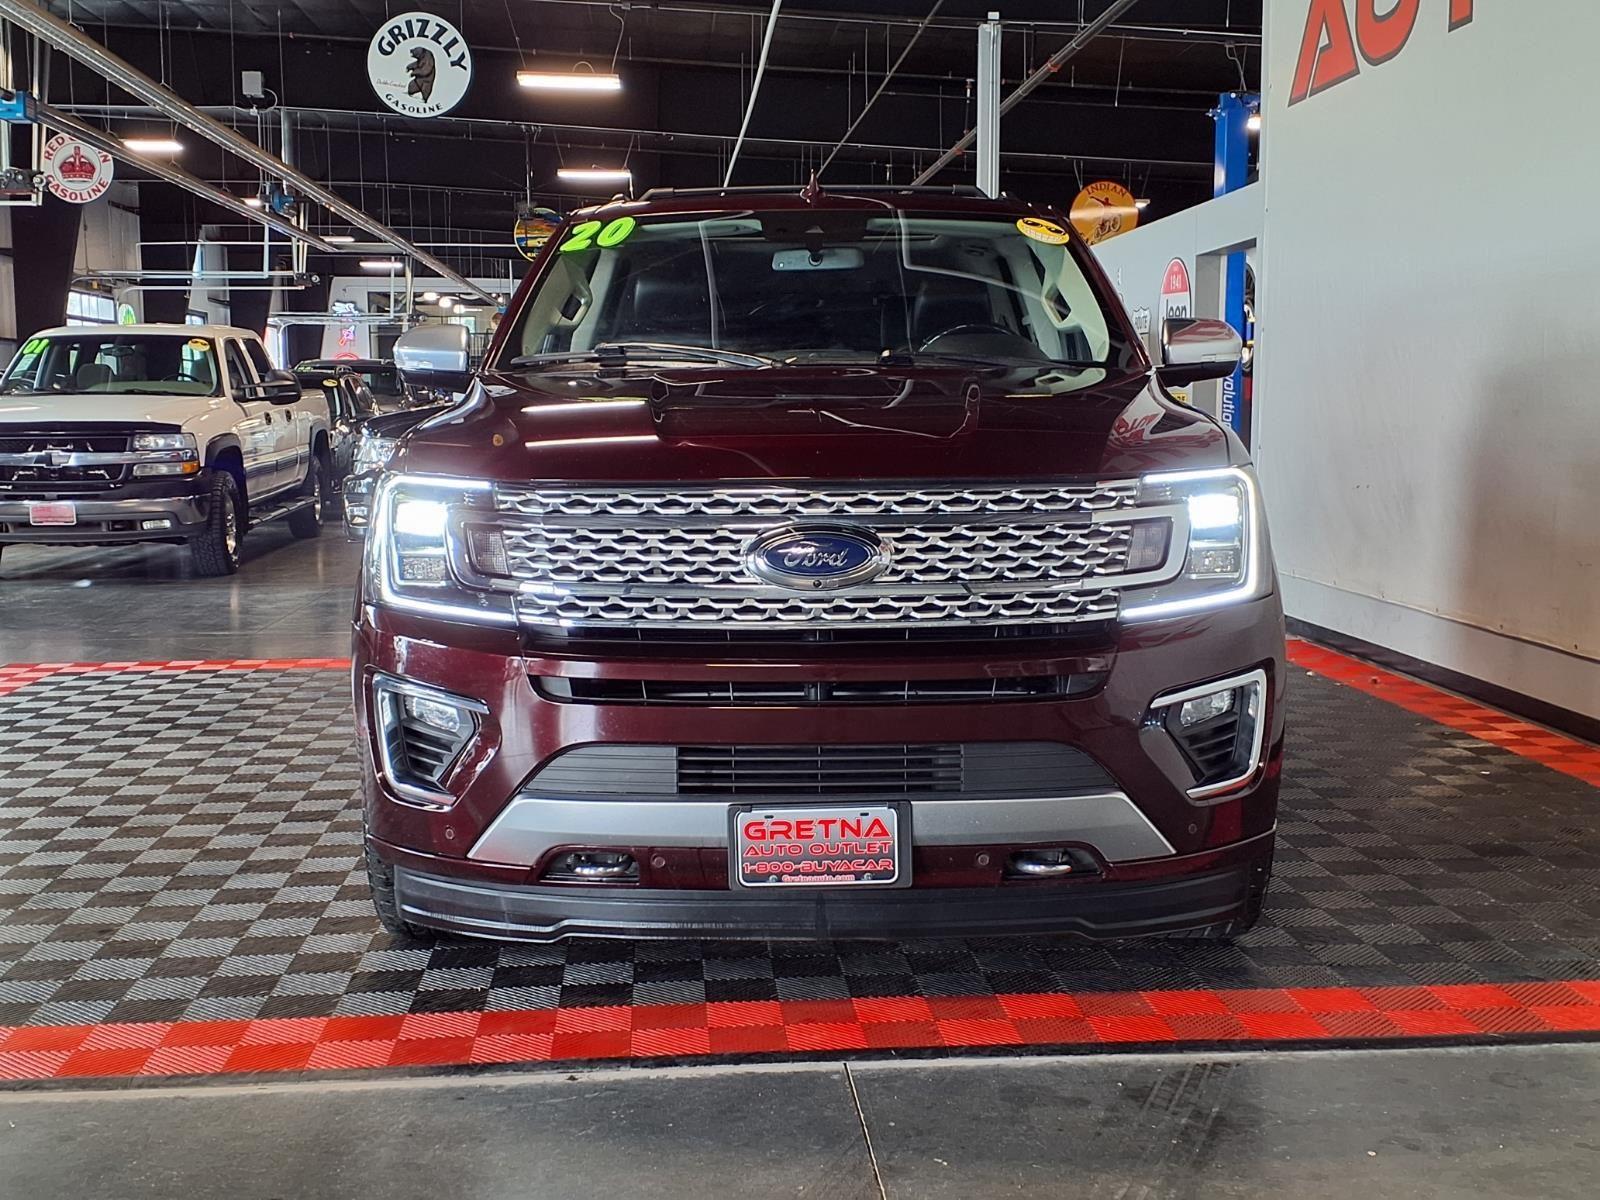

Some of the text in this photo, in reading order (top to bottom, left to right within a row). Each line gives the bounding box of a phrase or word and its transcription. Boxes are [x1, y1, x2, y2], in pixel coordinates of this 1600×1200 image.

[378, 18, 467, 71] GRIZZLY
[385, 93, 443, 114] GASOLINE
[44, 136, 66, 161] RED
[1086, 183, 1126, 198] INDIAN
[559, 216, 636, 252] 20
[777, 541, 849, 568] Ford
[743, 817, 892, 841] GRETNA
[743, 841, 893, 857] AUTO OUTLET
[743, 859, 894, 874] 1-800-BUYACAR
